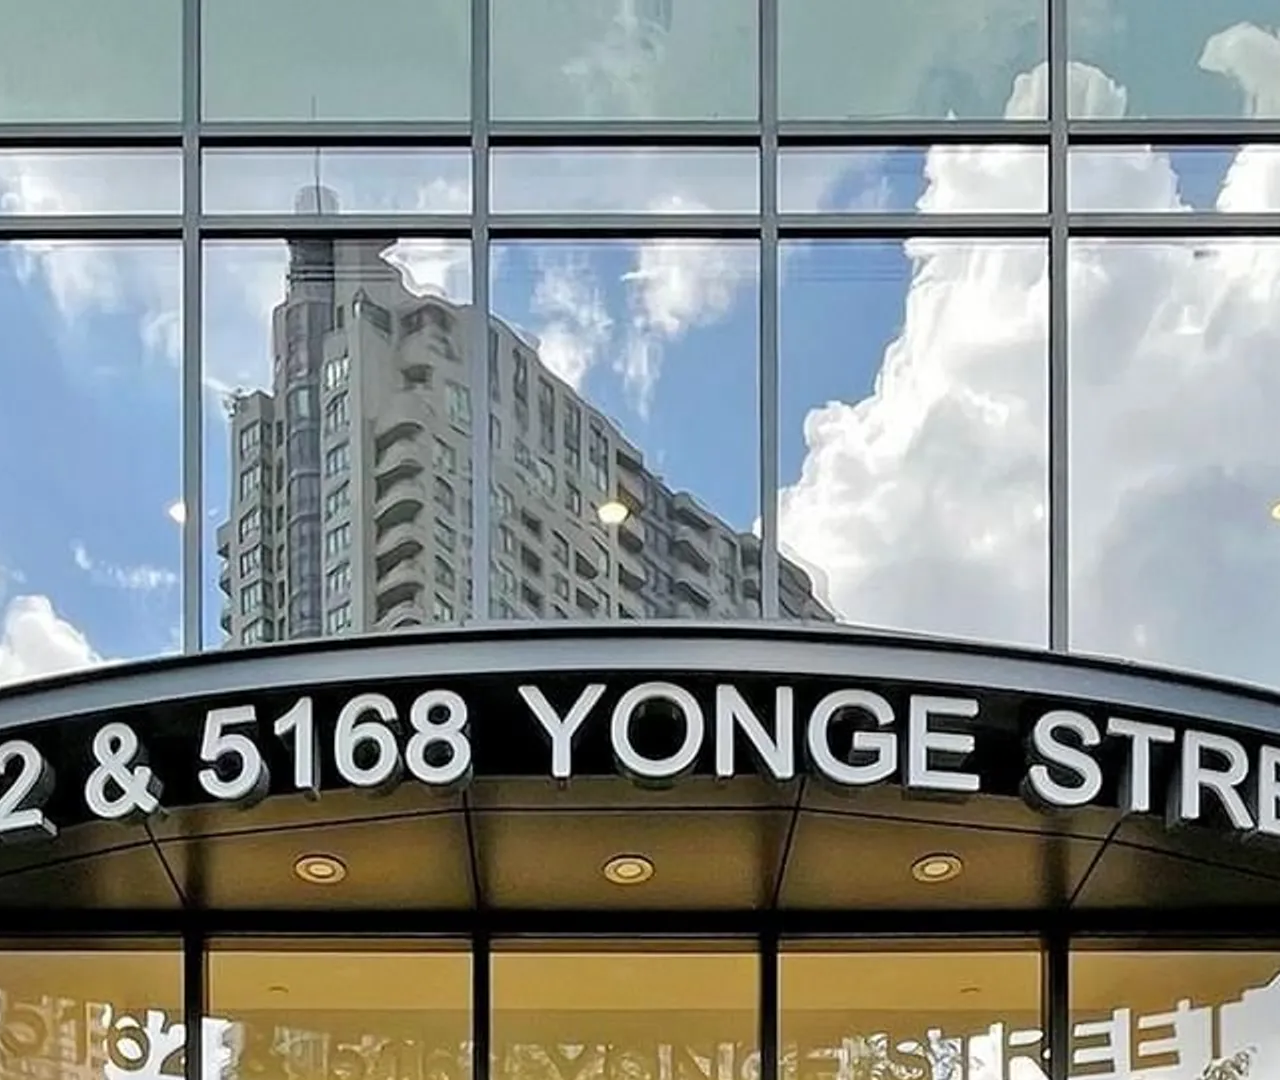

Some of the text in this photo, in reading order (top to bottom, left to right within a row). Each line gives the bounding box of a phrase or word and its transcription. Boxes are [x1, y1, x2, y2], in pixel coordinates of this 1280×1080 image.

[84, 721, 162, 820] &
[198, 688, 472, 802] 5168
[518, 682, 980, 793] YONGE
